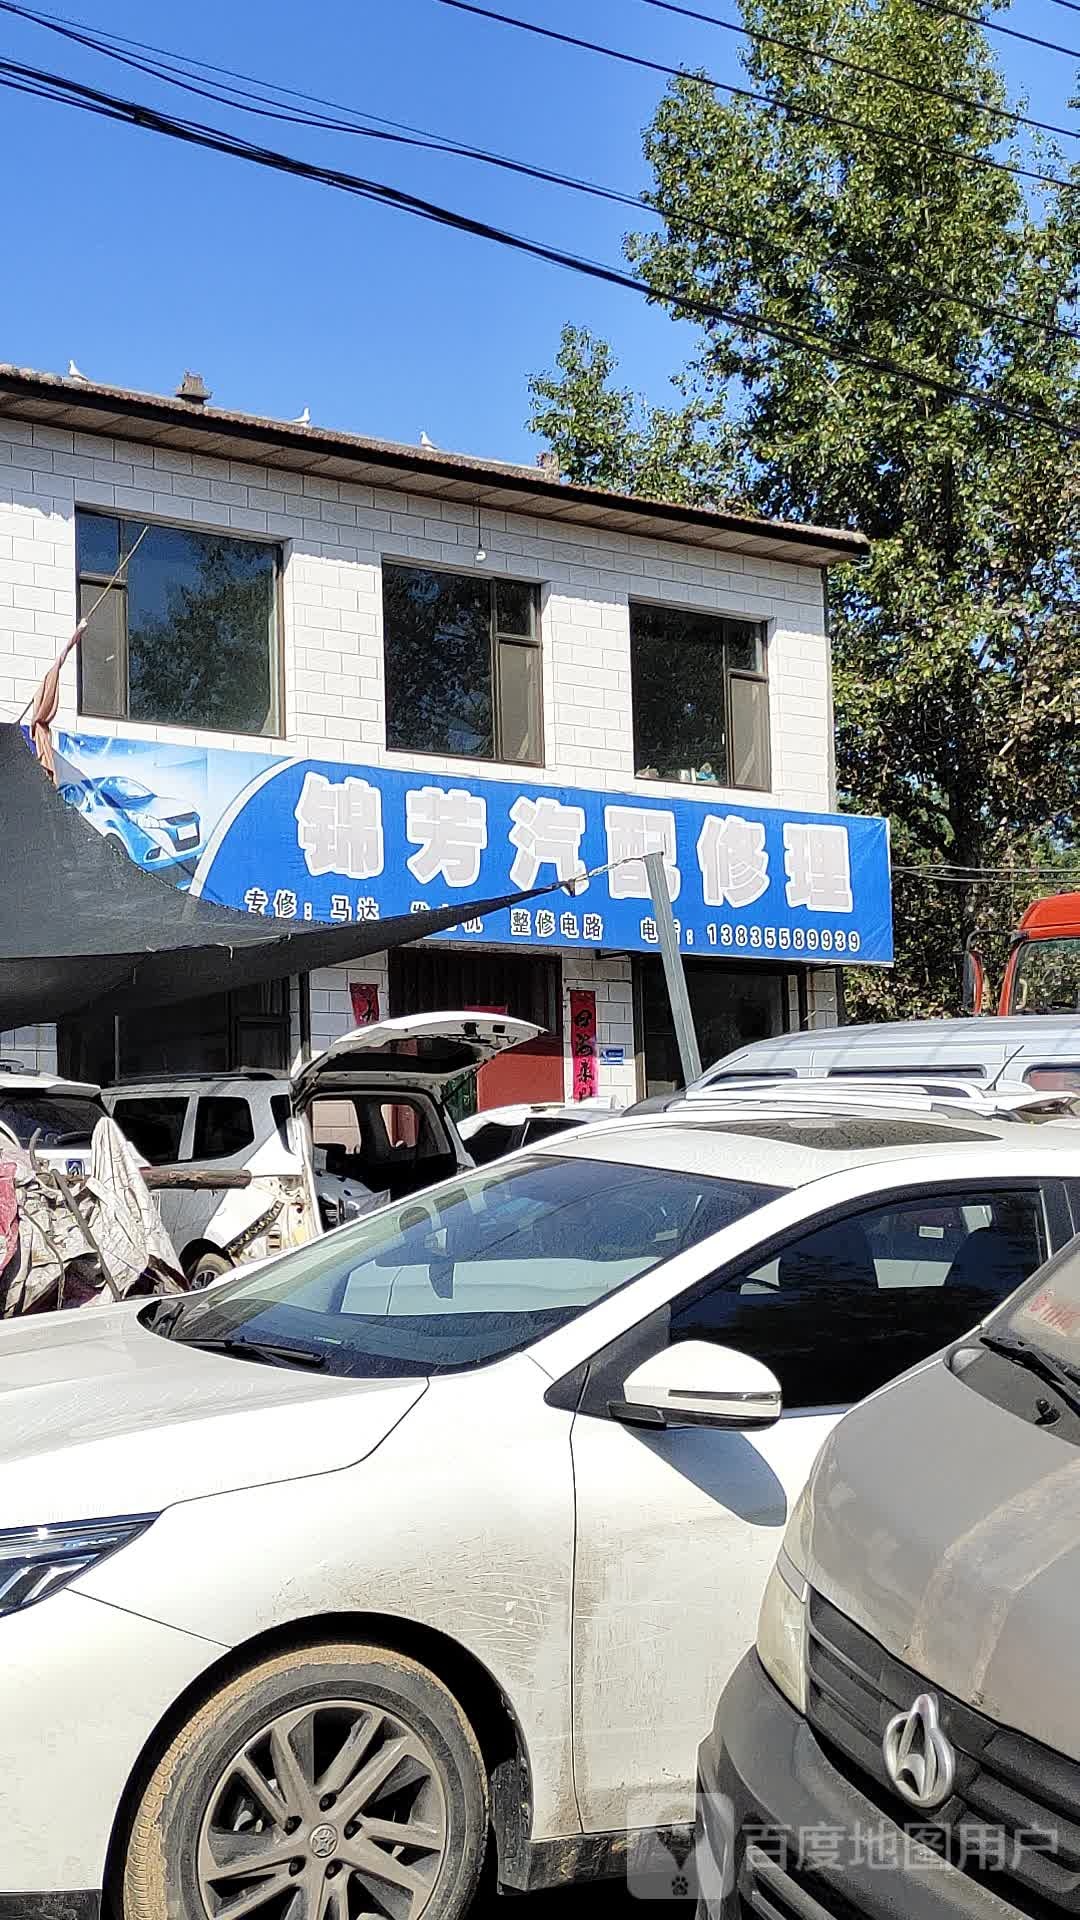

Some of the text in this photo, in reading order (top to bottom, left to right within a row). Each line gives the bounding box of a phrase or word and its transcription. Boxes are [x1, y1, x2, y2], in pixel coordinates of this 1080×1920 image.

[294, 771, 853, 913] 锦芳汽配修理
[510, 907, 604, 941] 整修电路
